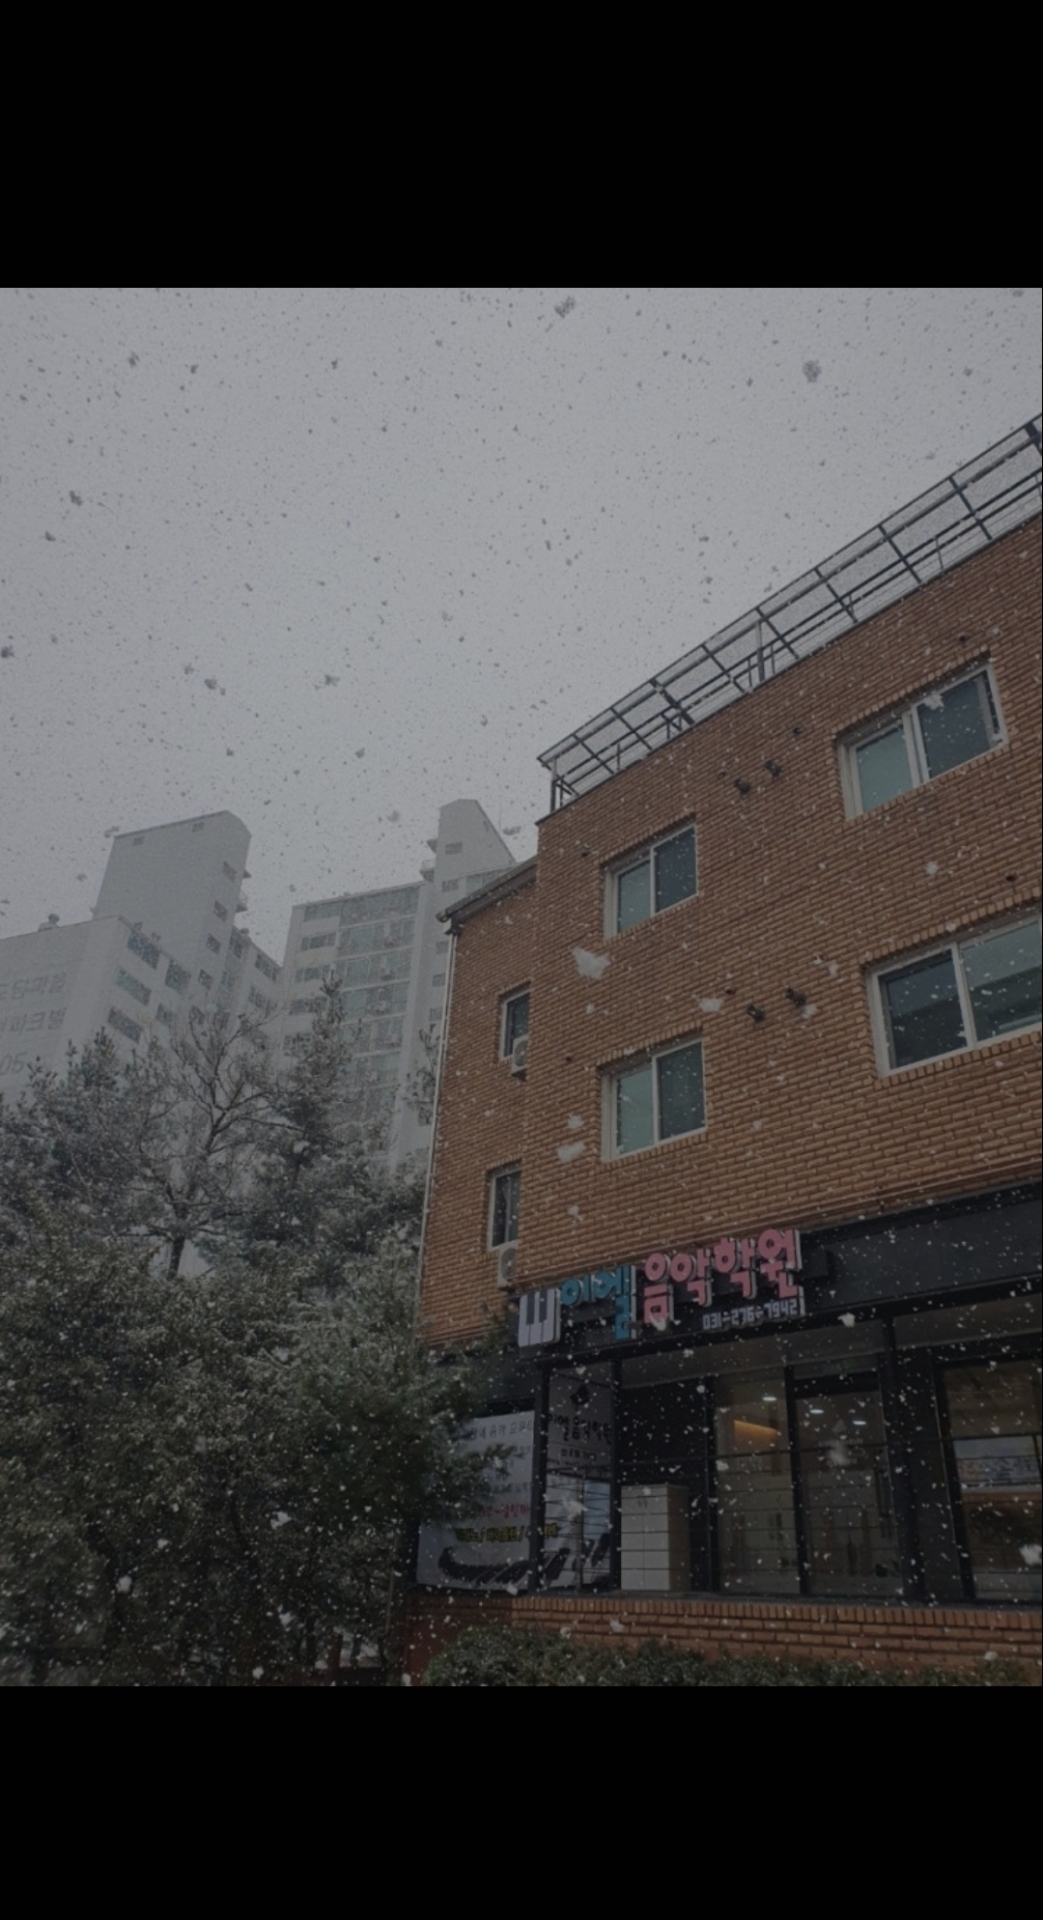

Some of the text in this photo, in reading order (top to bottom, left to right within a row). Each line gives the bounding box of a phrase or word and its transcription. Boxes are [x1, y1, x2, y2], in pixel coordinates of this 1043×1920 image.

[560, 1228, 800, 1340] 이엘 음악학원
[702, 1300, 798, 1330] 031-276-7942
